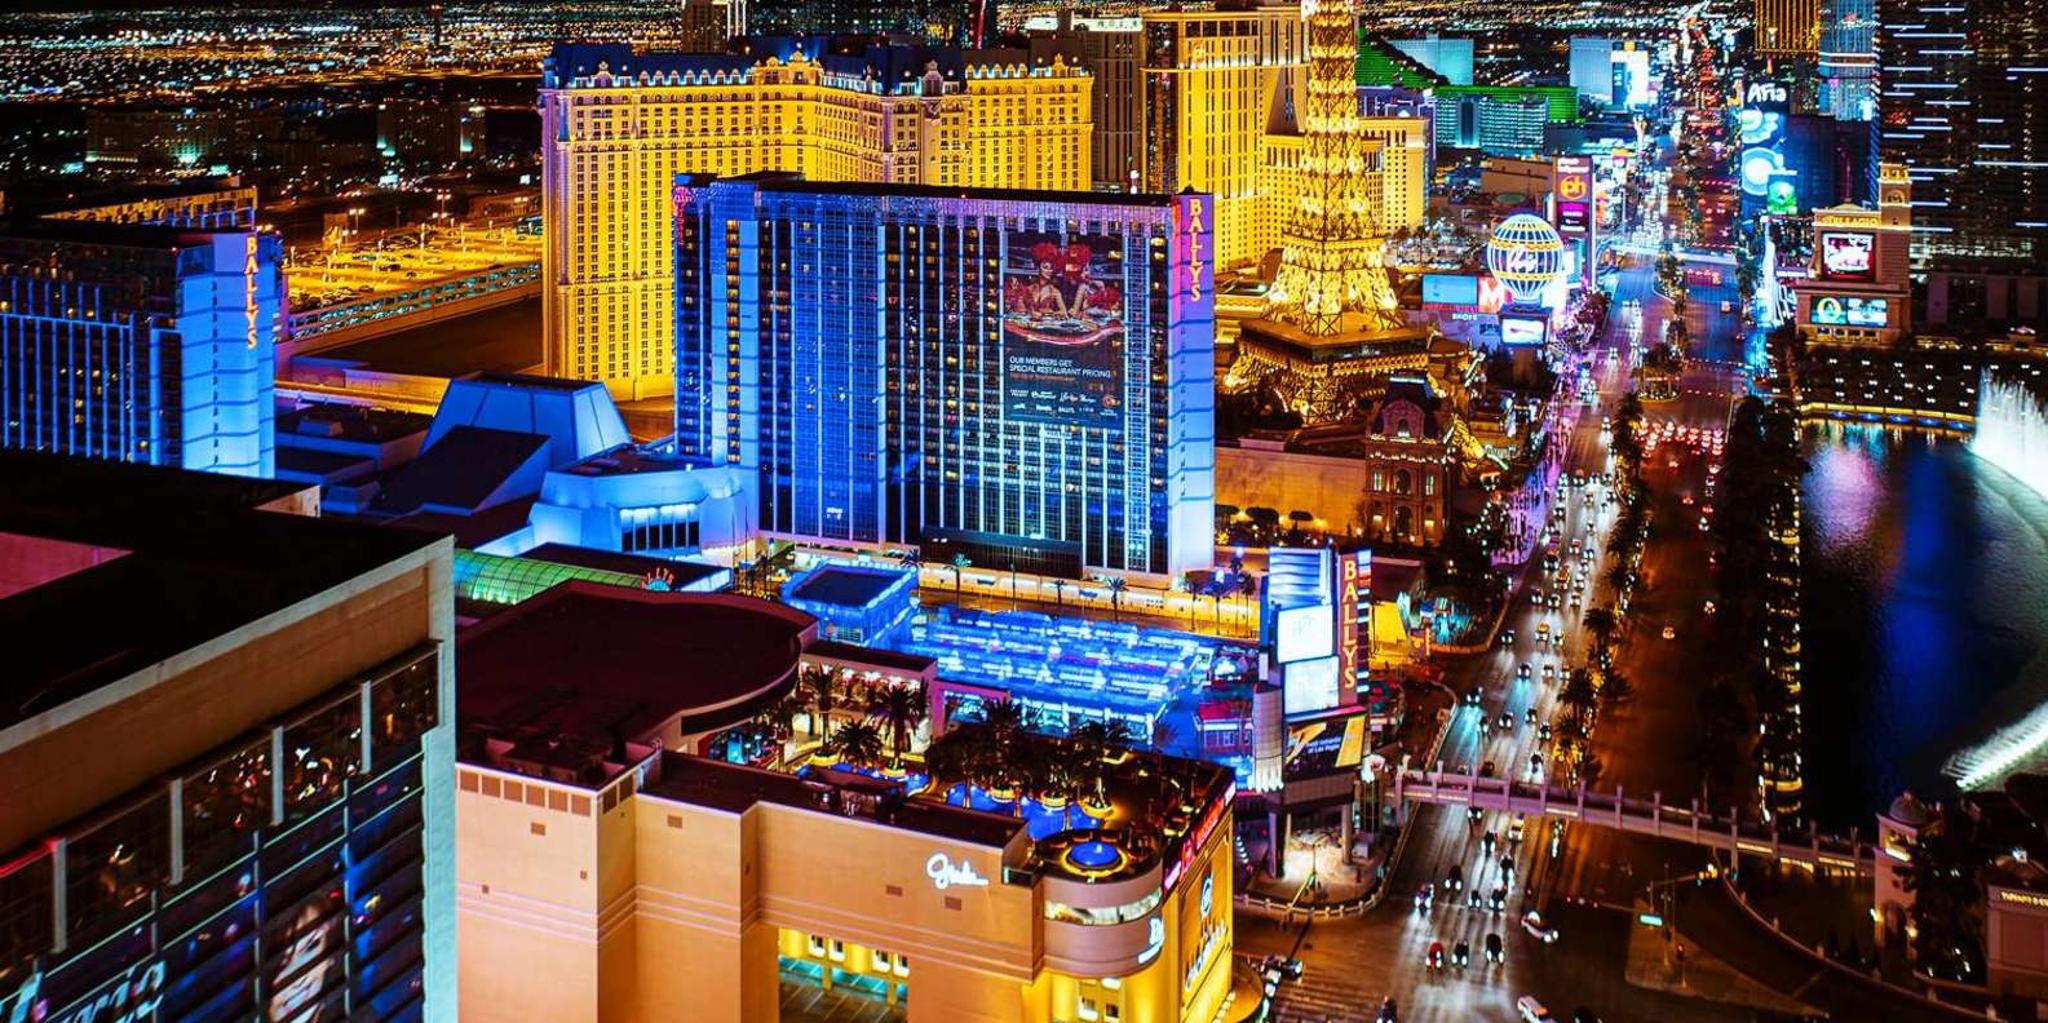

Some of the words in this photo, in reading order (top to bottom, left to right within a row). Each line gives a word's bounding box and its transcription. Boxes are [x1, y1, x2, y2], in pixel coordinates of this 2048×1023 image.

[243, 236, 259, 349] BALLYS
[1187, 198, 1204, 302] BALLYS
[1342, 559, 1359, 689] BALLYS
